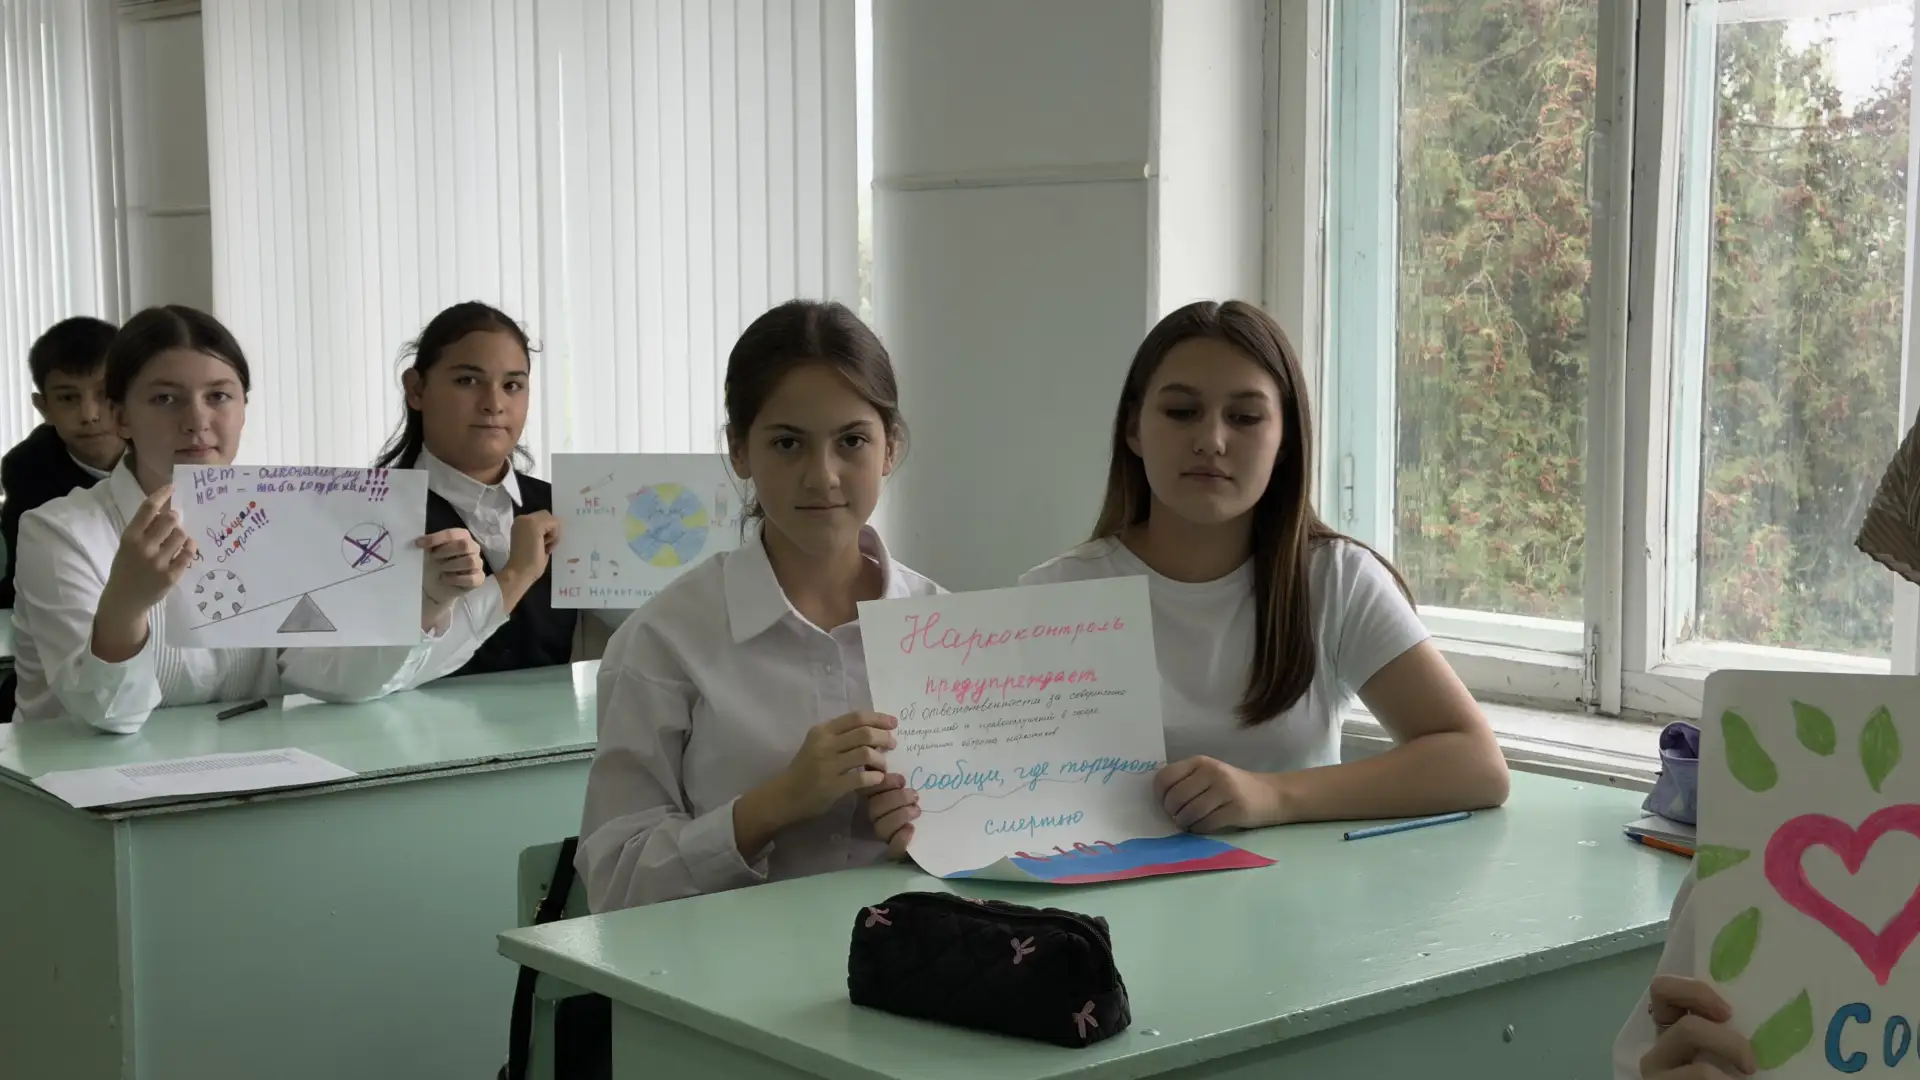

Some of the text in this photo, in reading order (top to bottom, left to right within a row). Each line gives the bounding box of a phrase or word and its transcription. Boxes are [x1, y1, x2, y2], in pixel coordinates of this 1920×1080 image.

[900, 612, 1125, 666] Наркоконтроль
[925, 669, 1098, 705] предупреждает
[1061, 709, 1068, 719] в
[910, 760, 1004, 792] Сообщи,
[1014, 762, 1049, 791] где
[985, 810, 1084, 837] смертью
[1825, 1002, 1920, 1075] Со
